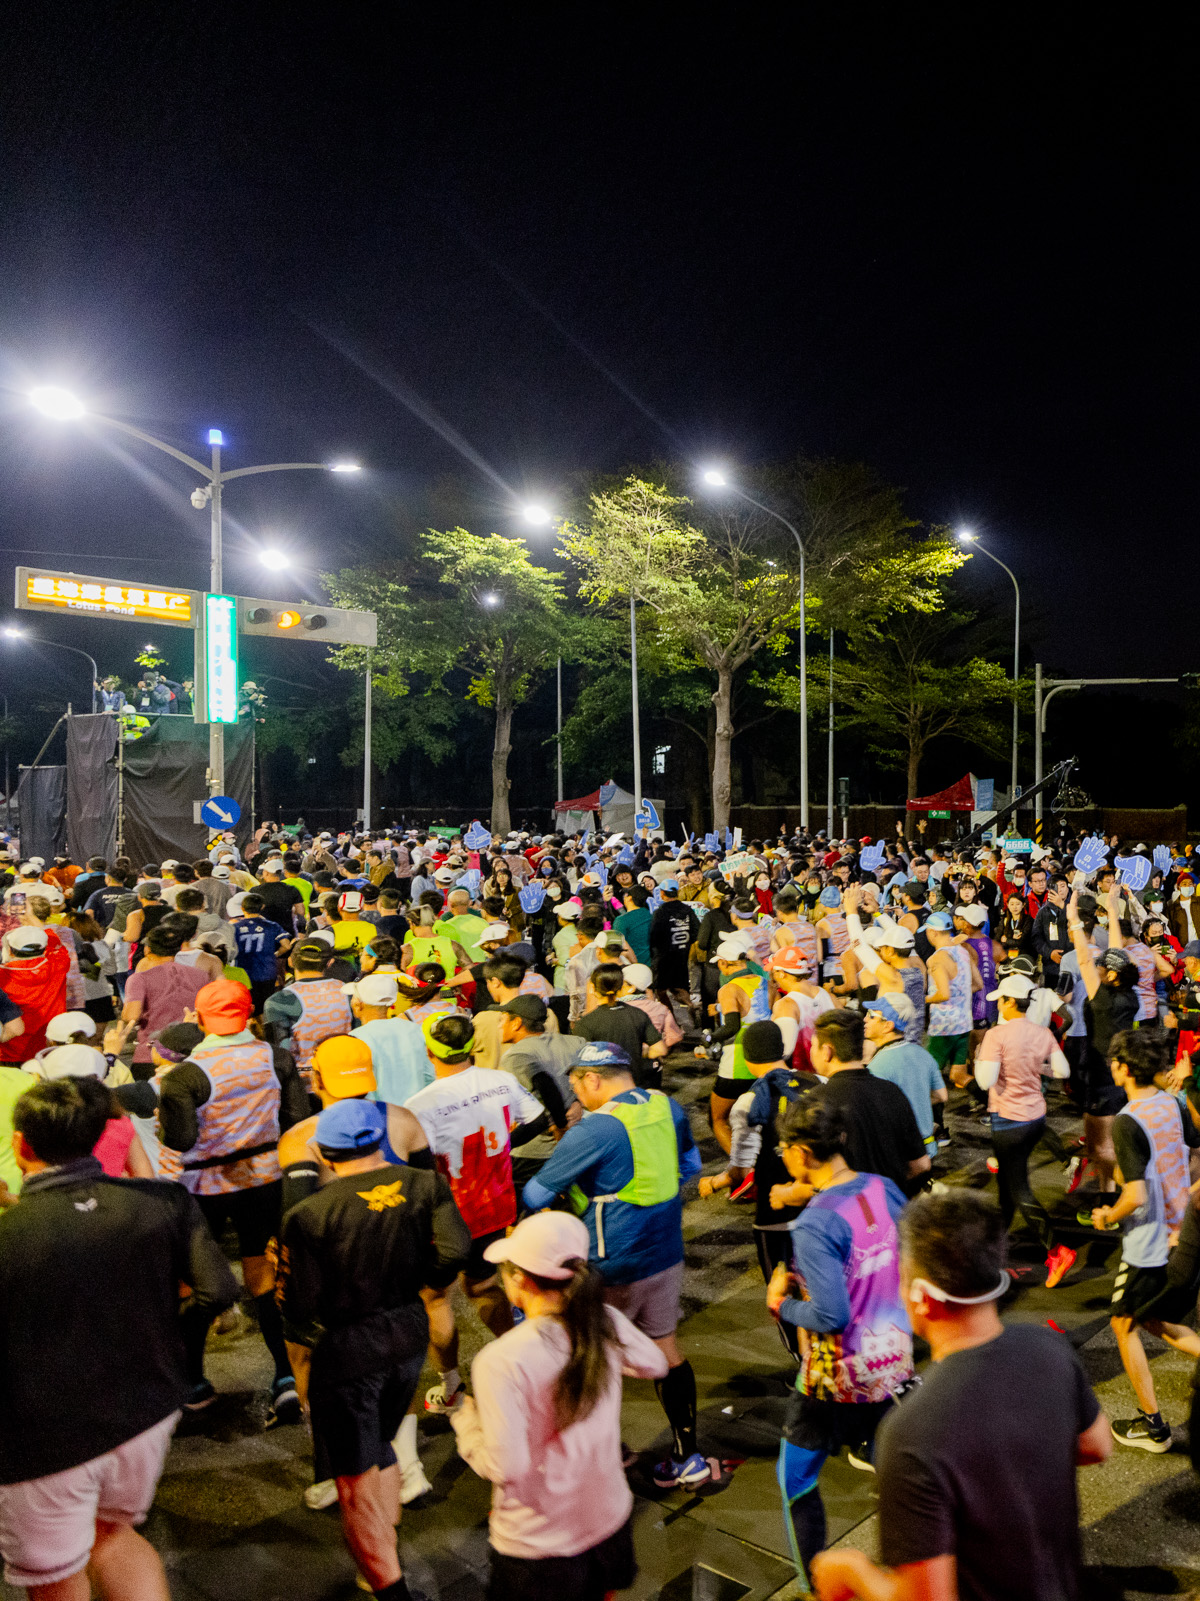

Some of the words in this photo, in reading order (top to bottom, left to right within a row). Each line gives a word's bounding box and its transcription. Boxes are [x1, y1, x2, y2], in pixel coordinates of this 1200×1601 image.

[67, 600, 101, 612] Lotus
[104, 603, 136, 616] Pond
[239, 933, 265, 953] 77
